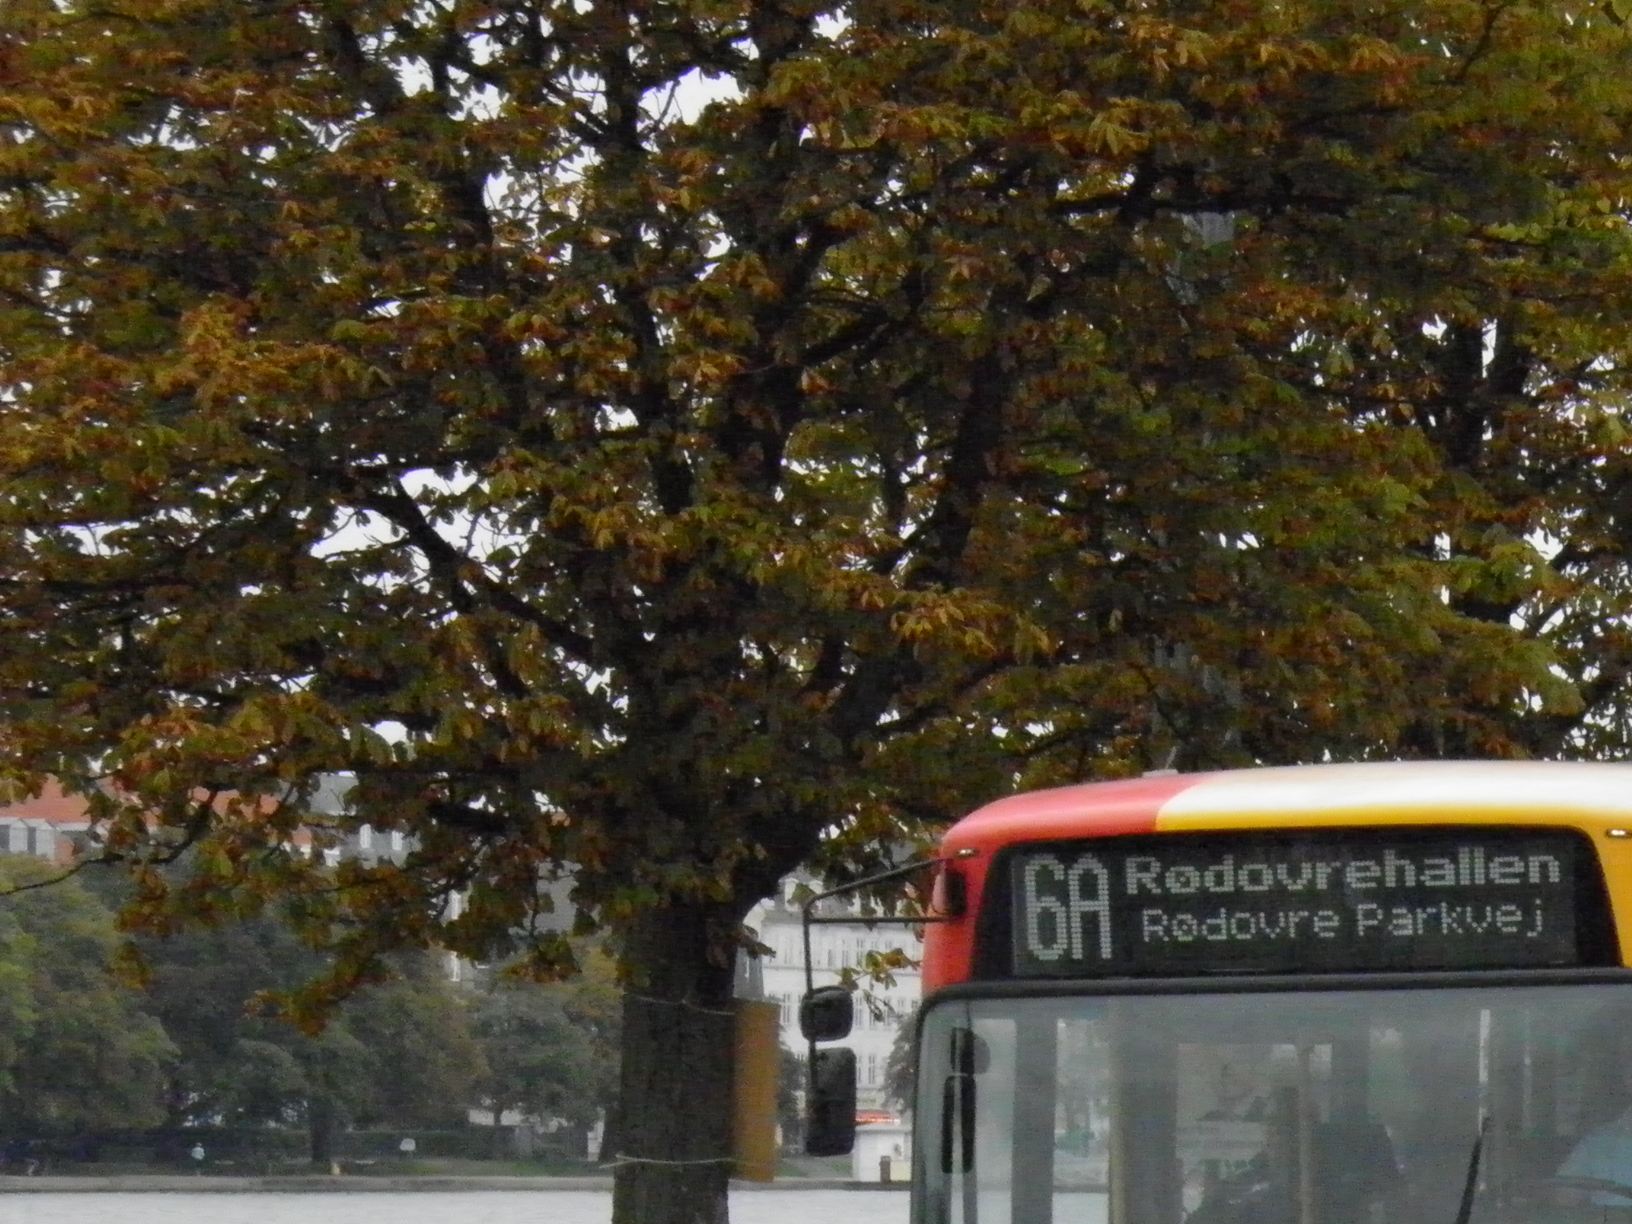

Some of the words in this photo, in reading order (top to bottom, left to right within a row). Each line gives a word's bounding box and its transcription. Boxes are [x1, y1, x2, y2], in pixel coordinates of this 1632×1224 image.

[1124, 846, 1561, 895] Rødovrehallen
[1024, 853, 1113, 961] 6A
[1355, 898, 1544, 938] Parkvej
